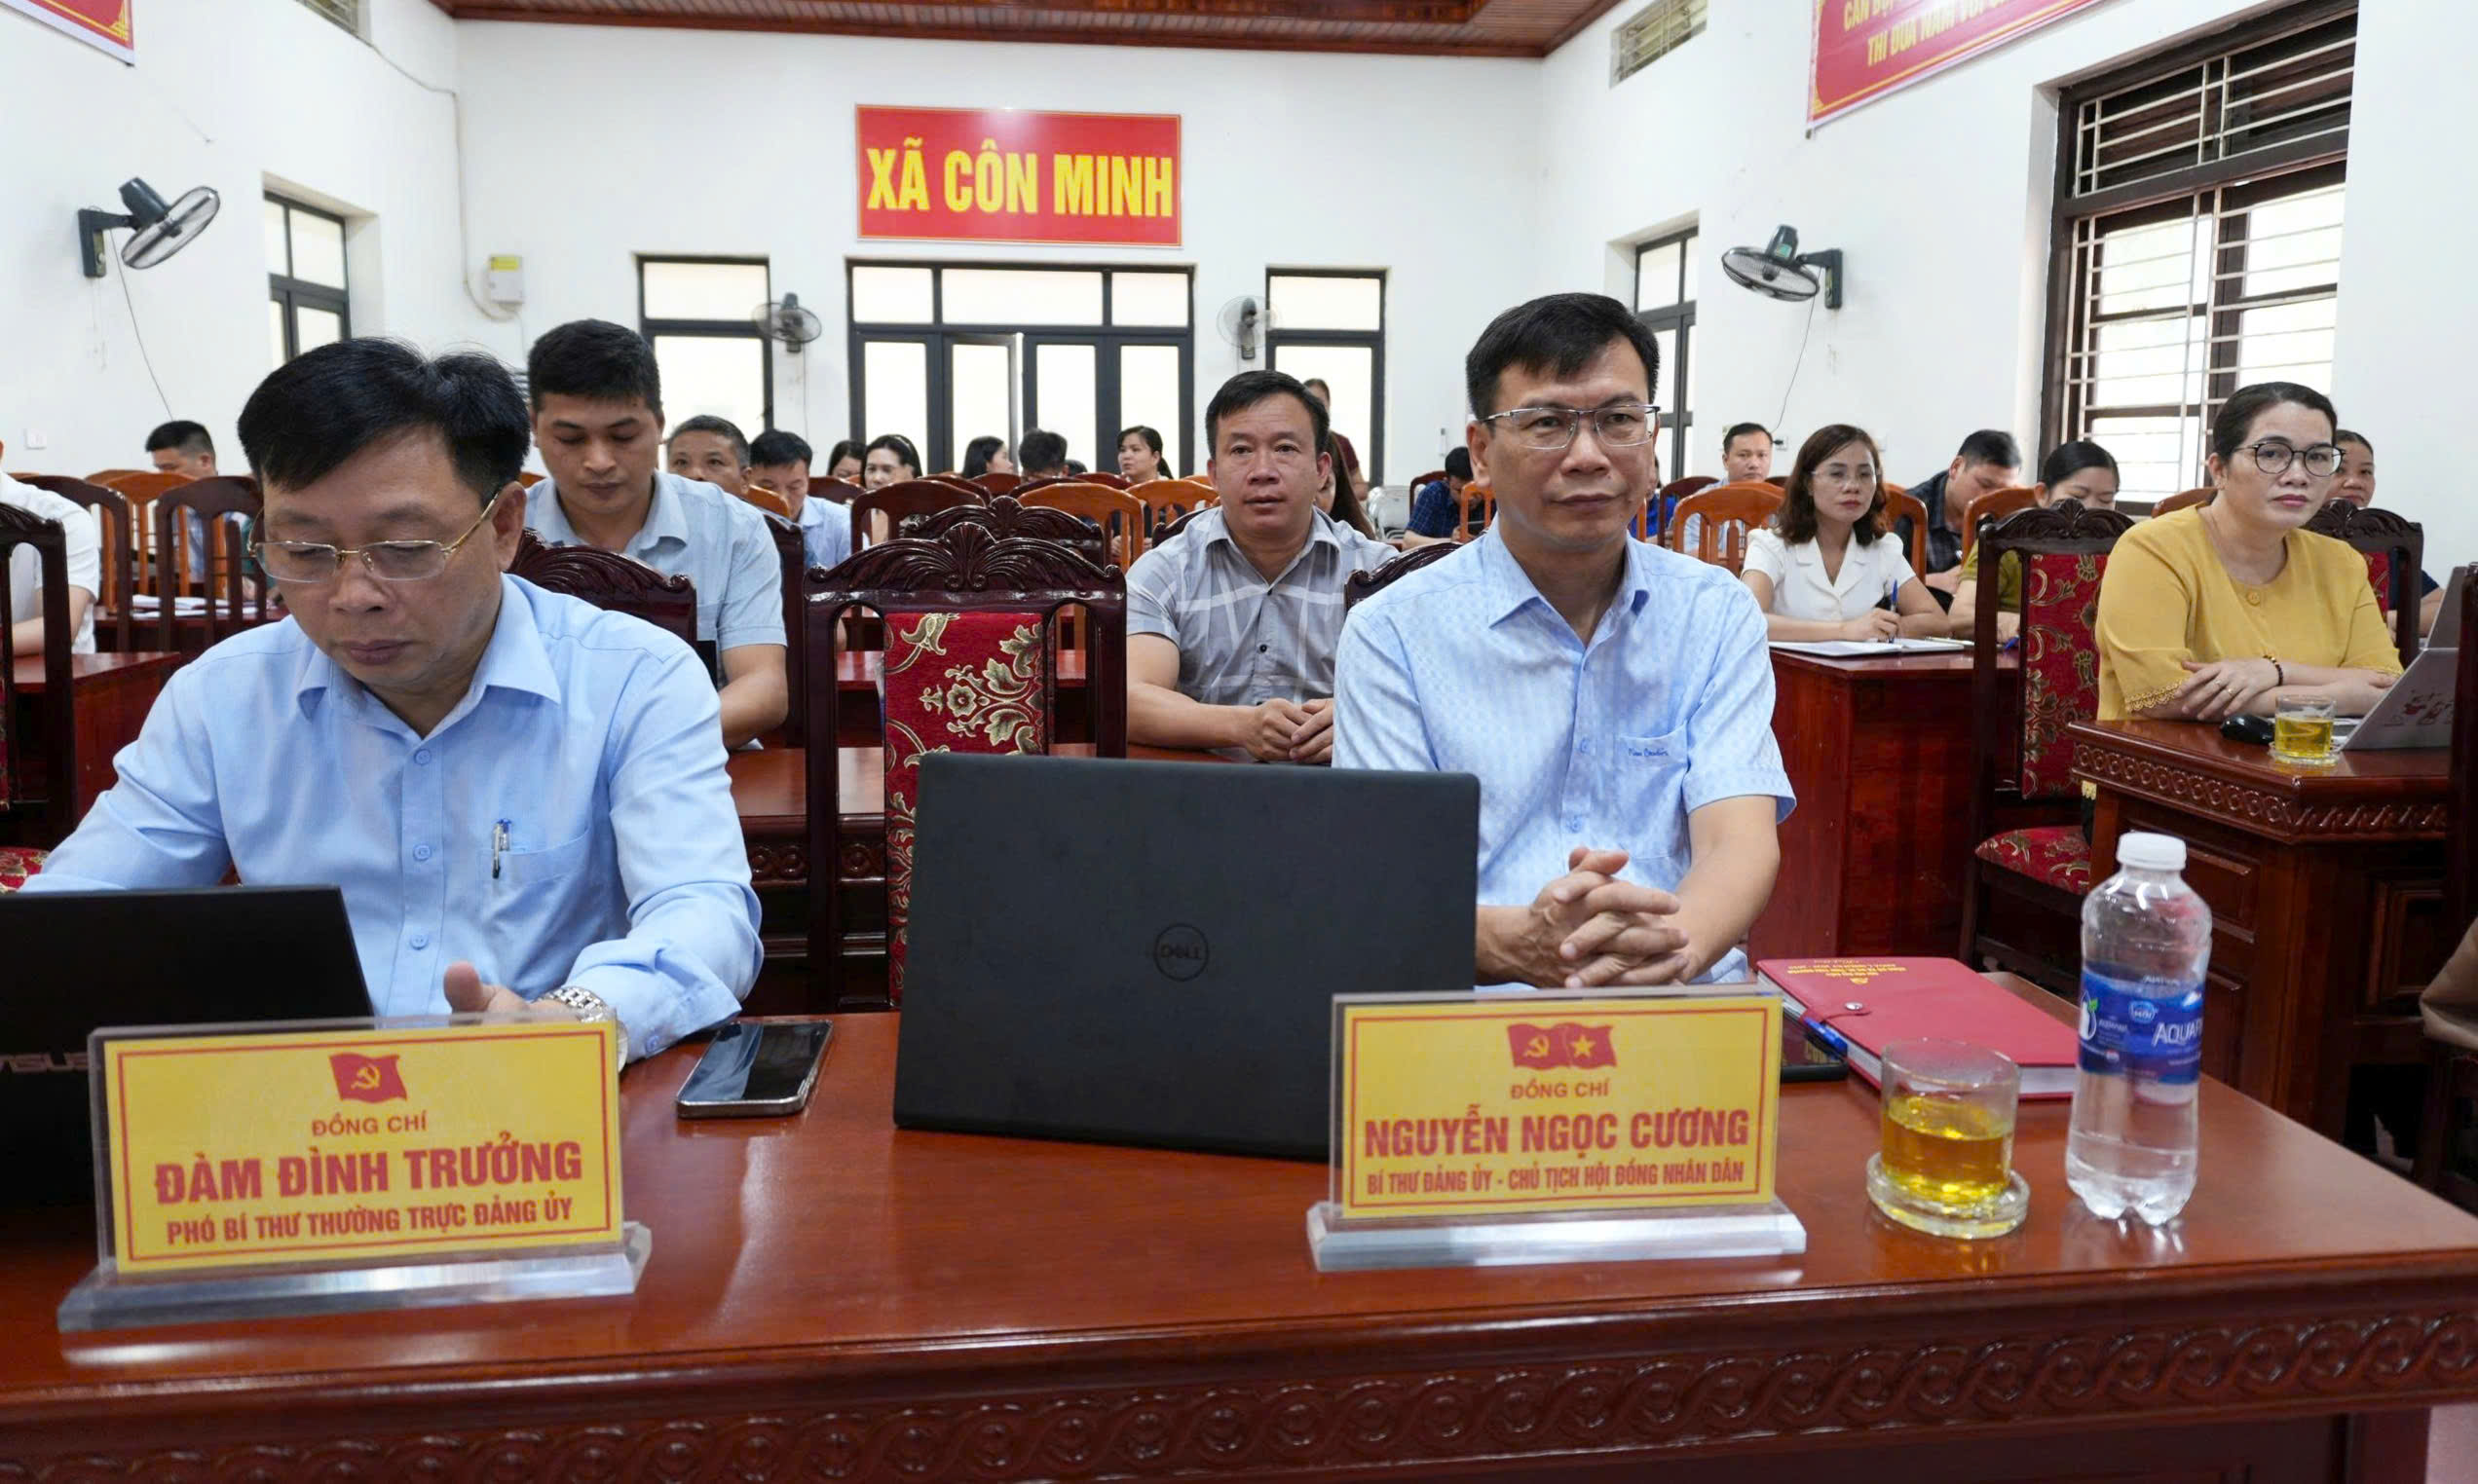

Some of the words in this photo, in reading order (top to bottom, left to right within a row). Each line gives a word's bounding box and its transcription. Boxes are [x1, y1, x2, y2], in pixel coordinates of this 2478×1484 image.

[867, 136, 930, 211] XÃ
[944, 138, 1038, 214] CÔN
[1054, 154, 1173, 217] MINH
[1509, 1077, 1568, 1100] ĐỒNG
[1574, 1077, 1610, 1098] CHÍ
[311, 1111, 379, 1137] ĐỒNG
[387, 1109, 427, 1133] CHÍ
[1365, 1103, 1510, 1158] NGUYỄN
[1521, 1113, 1619, 1160] NGỌC
[1630, 1106, 1750, 1149] CƯƠNG
[154, 1152, 263, 1206] ĐÀM
[277, 1146, 390, 1198] ĐÌNH
[404, 1131, 582, 1188] TRƯỞNG
[1367, 1169, 1384, 1196] BÍ
[1388, 1169, 1421, 1195] THƯ
[1422, 1164, 1468, 1194] ĐẢNG
[1507, 1161, 1541, 1191] CHỦ
[1544, 1166, 1581, 1194] TỊCH
[1583, 1162, 1611, 1193] HỘI
[1662, 1158, 1708, 1185] NHÂN
[1710, 1156, 1745, 1184] DÂN
[167, 1214, 216, 1245] PHÓ
[223, 1212, 248, 1242] BÍ
[254, 1211, 302, 1241] THƯ
[306, 1205, 400, 1237] THƯỜNG
[406, 1202, 468, 1234] TRỰC
[472, 1194, 538, 1227] ĐẢNG
[544, 1190, 573, 1222] ỦY
